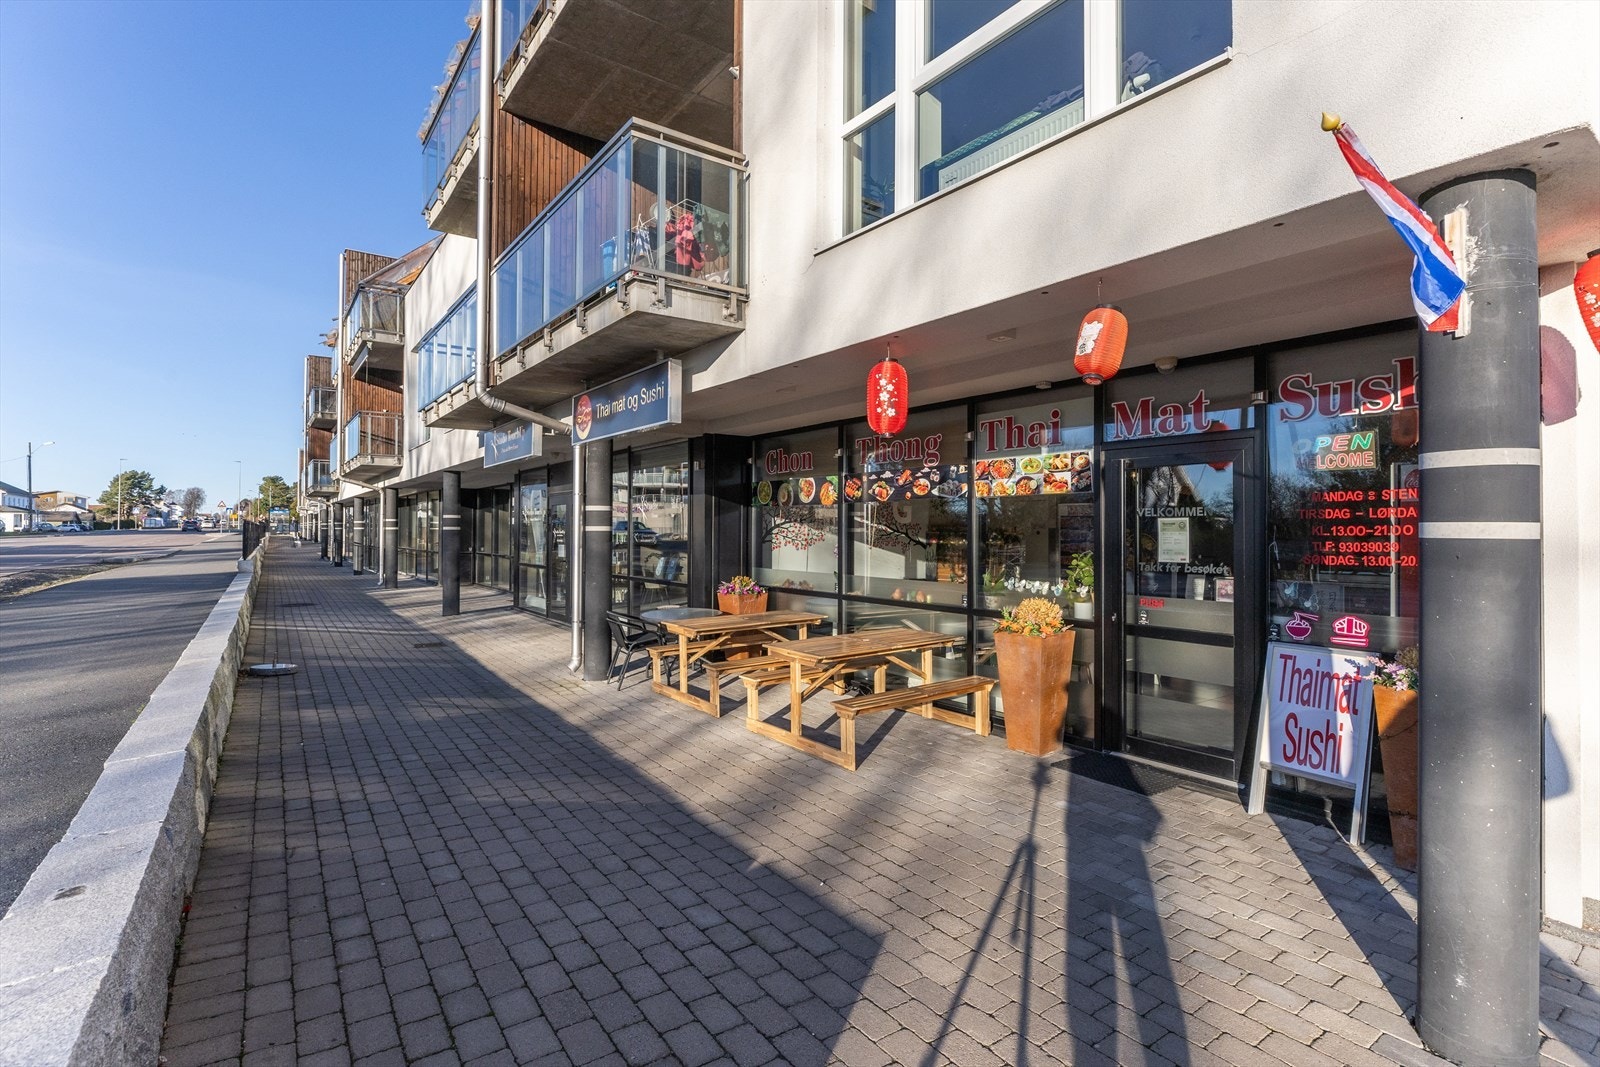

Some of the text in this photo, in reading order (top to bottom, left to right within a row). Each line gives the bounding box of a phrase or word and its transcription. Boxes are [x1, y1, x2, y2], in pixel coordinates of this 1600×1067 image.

[595, 381, 665, 419] Thai mat og Sushi
[765, 448, 814, 475] Chon
[855, 433, 943, 468] Thong
[979, 408, 1063, 453] Thai
[1111, 389, 1212, 440] Mat
[1312, 490, 1364, 502] MANDAG
[1137, 506, 1213, 518] VELKOMMEN
[1299, 508, 1351, 520] TIRSDAG
[1338, 541, 1400, 553] 93039039
[1139, 561, 1164, 572] Takk
[1165, 561, 1182, 573] for
[1279, 653, 1362, 716] Thaimat
[1282, 712, 1344, 775] Sushi
